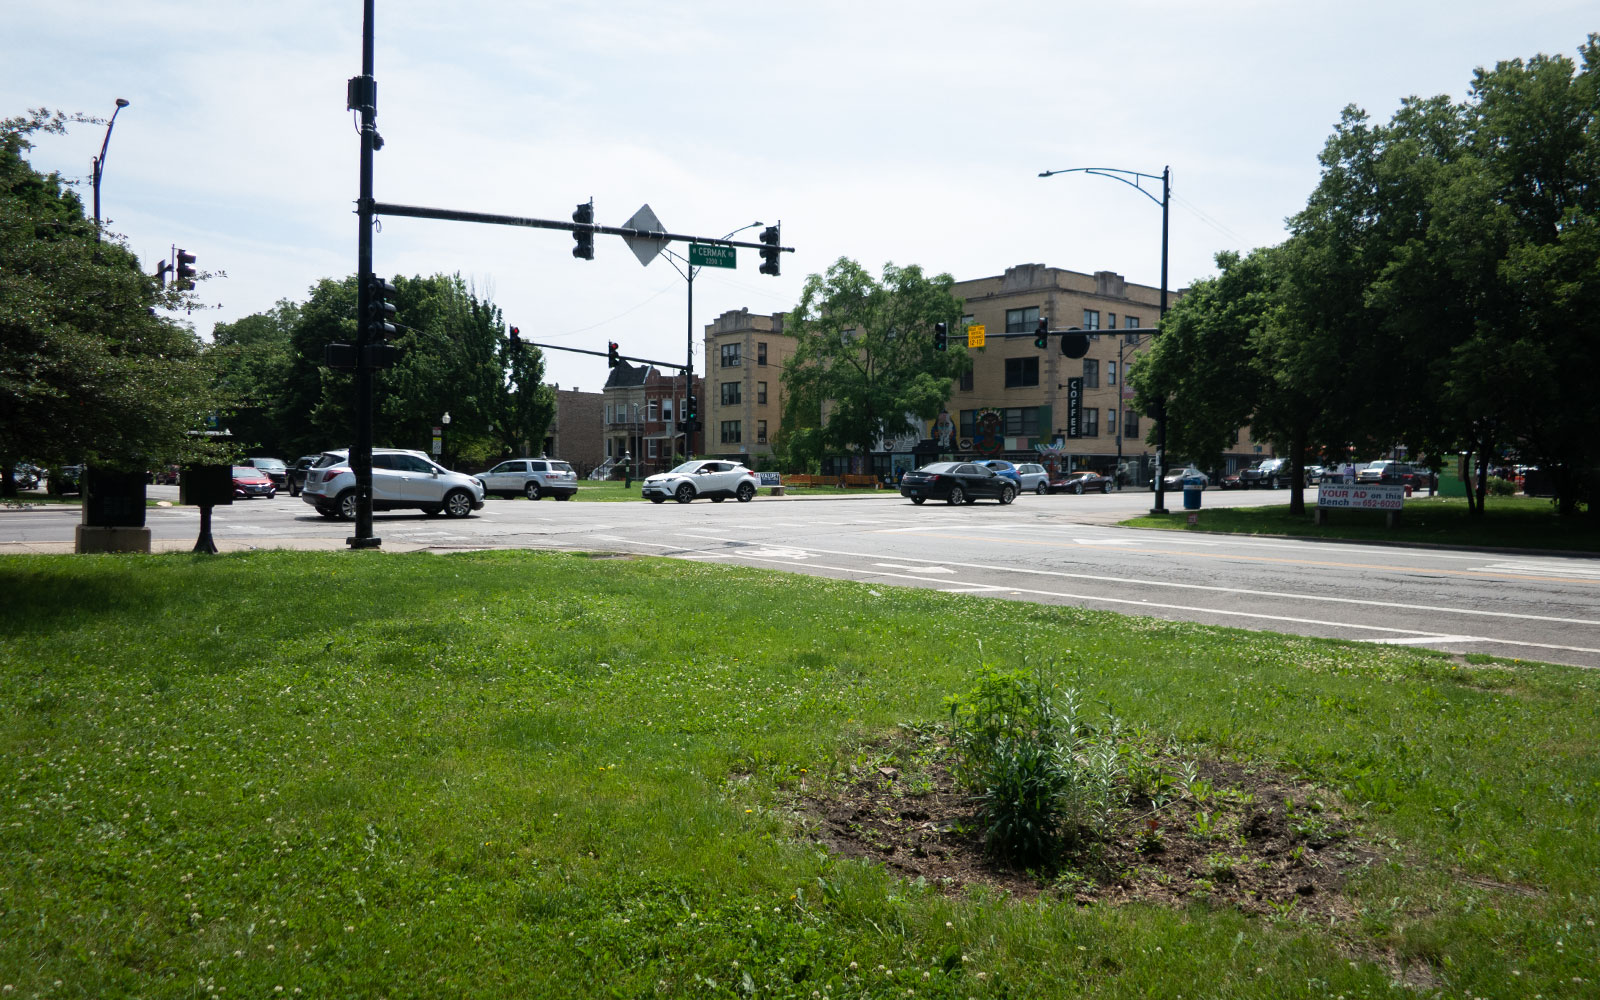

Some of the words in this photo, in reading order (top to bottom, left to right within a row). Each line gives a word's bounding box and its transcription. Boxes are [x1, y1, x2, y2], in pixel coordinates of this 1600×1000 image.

[698, 247, 727, 258] CERMAK
[1070, 380, 1078, 436] COFFEE
[1322, 489, 1349, 498] YOUR
[1352, 490, 1367, 499] AD
[1385, 492, 1402, 500] this
[1320, 497, 1349, 506] Bench
